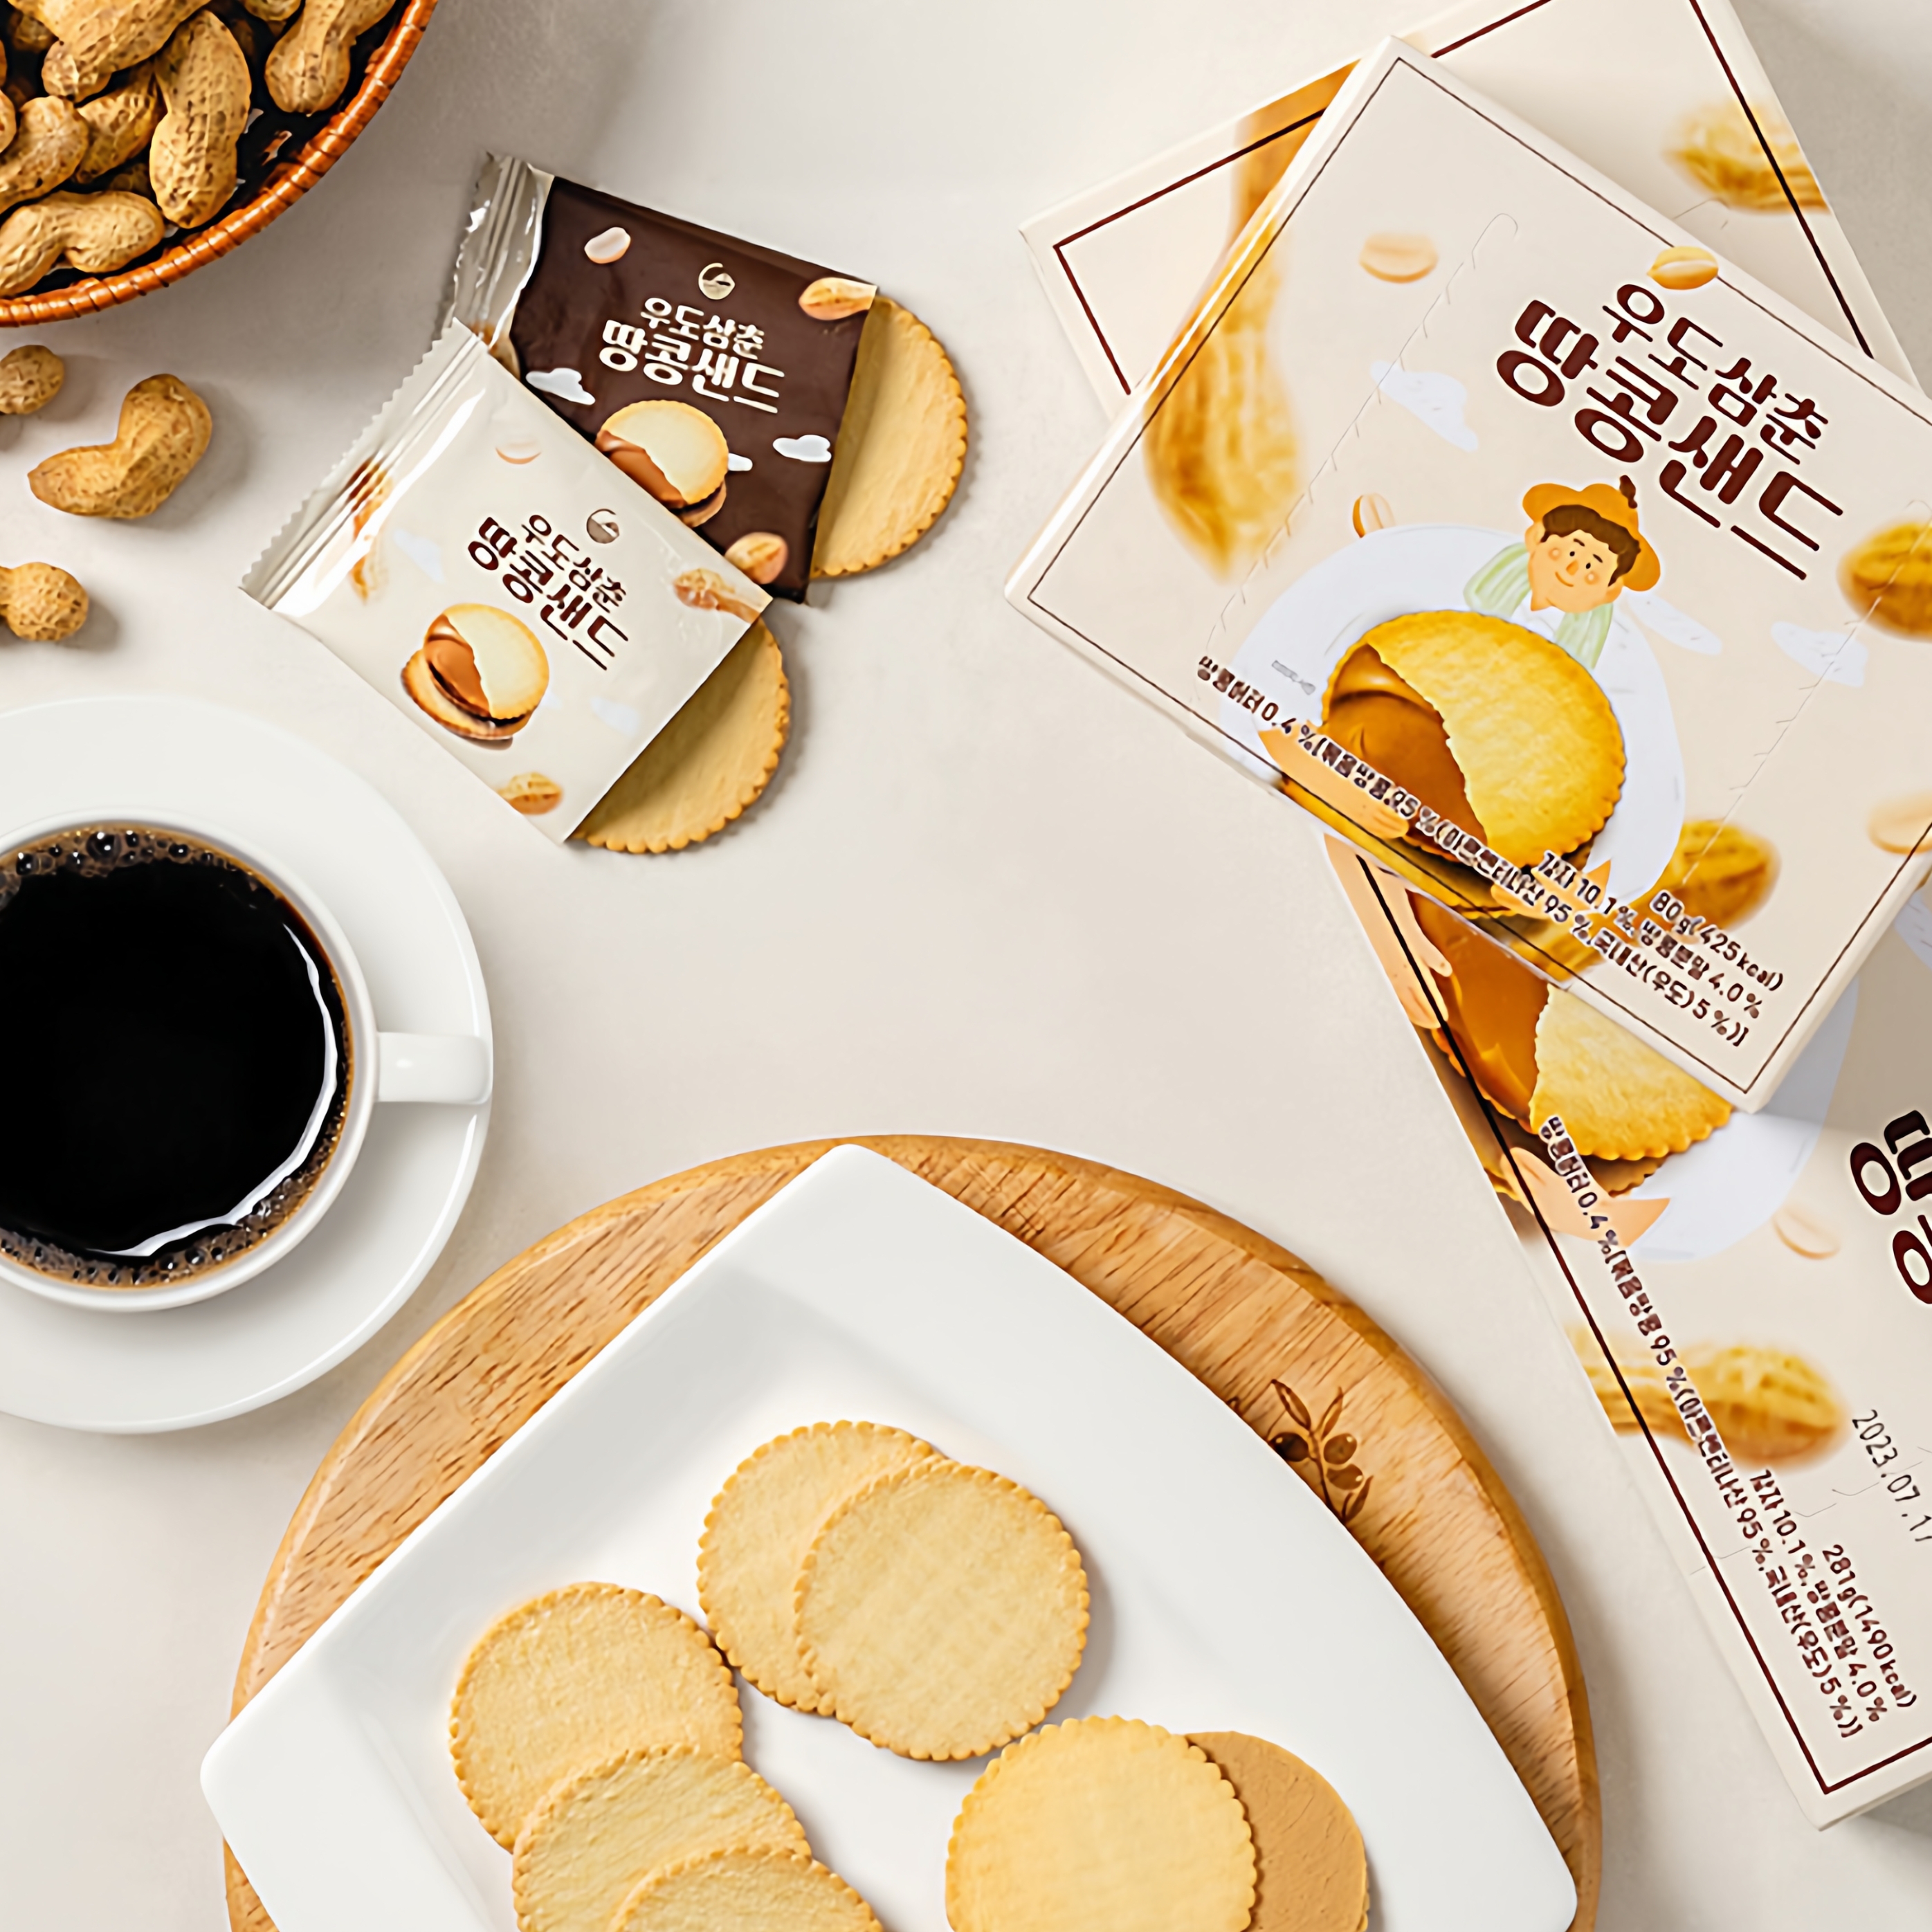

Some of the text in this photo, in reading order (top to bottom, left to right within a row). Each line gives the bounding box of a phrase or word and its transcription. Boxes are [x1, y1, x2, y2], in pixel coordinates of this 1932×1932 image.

[599, 320, 785, 414] 땅콩샌드
[640, 298, 764, 360] 우도삼춘
[1602, 284, 1828, 464] 우도삼춘
[1497, 300, 1843, 580] 땅콩샌드
[467, 517, 628, 671] 땅콩샌드
[521, 514, 626, 614] 우도삼춘
[1850, 1109, 1932, 1304] 땅
